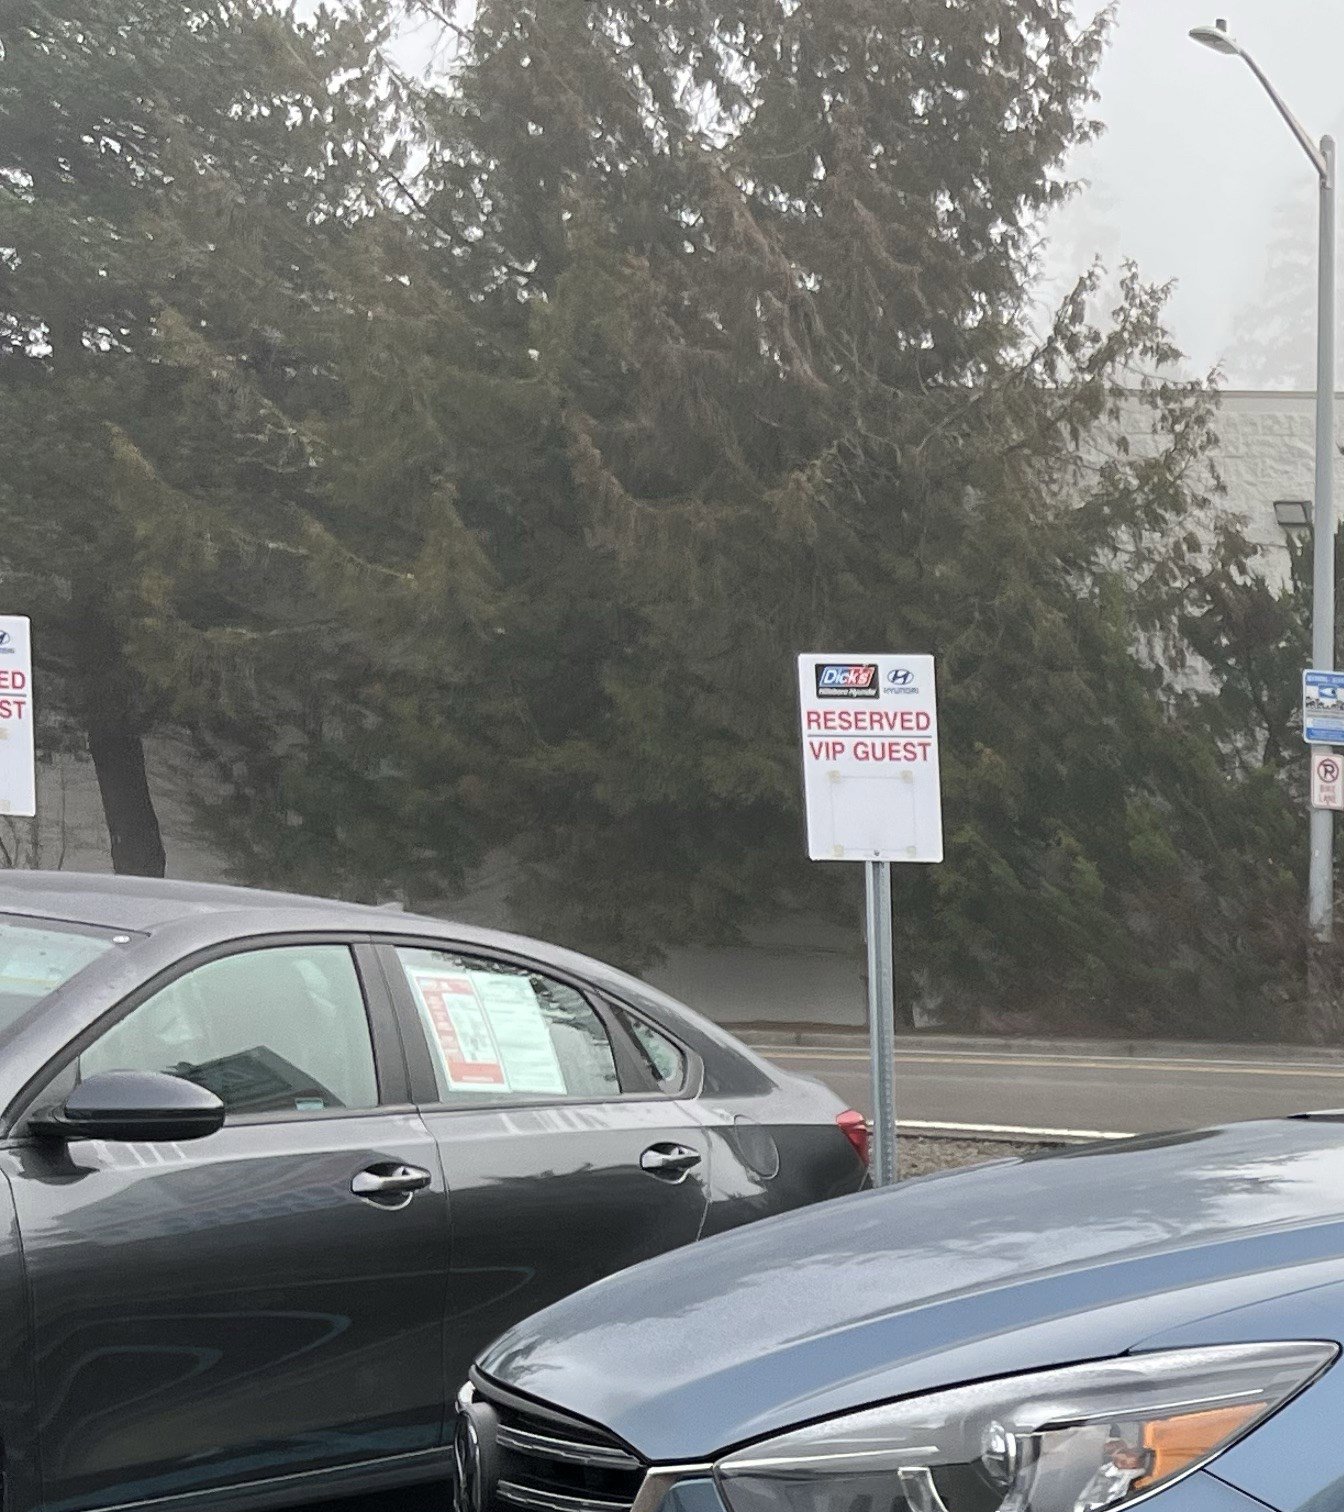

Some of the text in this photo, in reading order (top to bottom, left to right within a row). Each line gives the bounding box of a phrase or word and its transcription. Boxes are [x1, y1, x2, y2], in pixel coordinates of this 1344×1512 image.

[823, 667, 868, 685] Dick's
[806, 710, 931, 732] RESERVED
[808, 741, 932, 762] VIP GUEST
